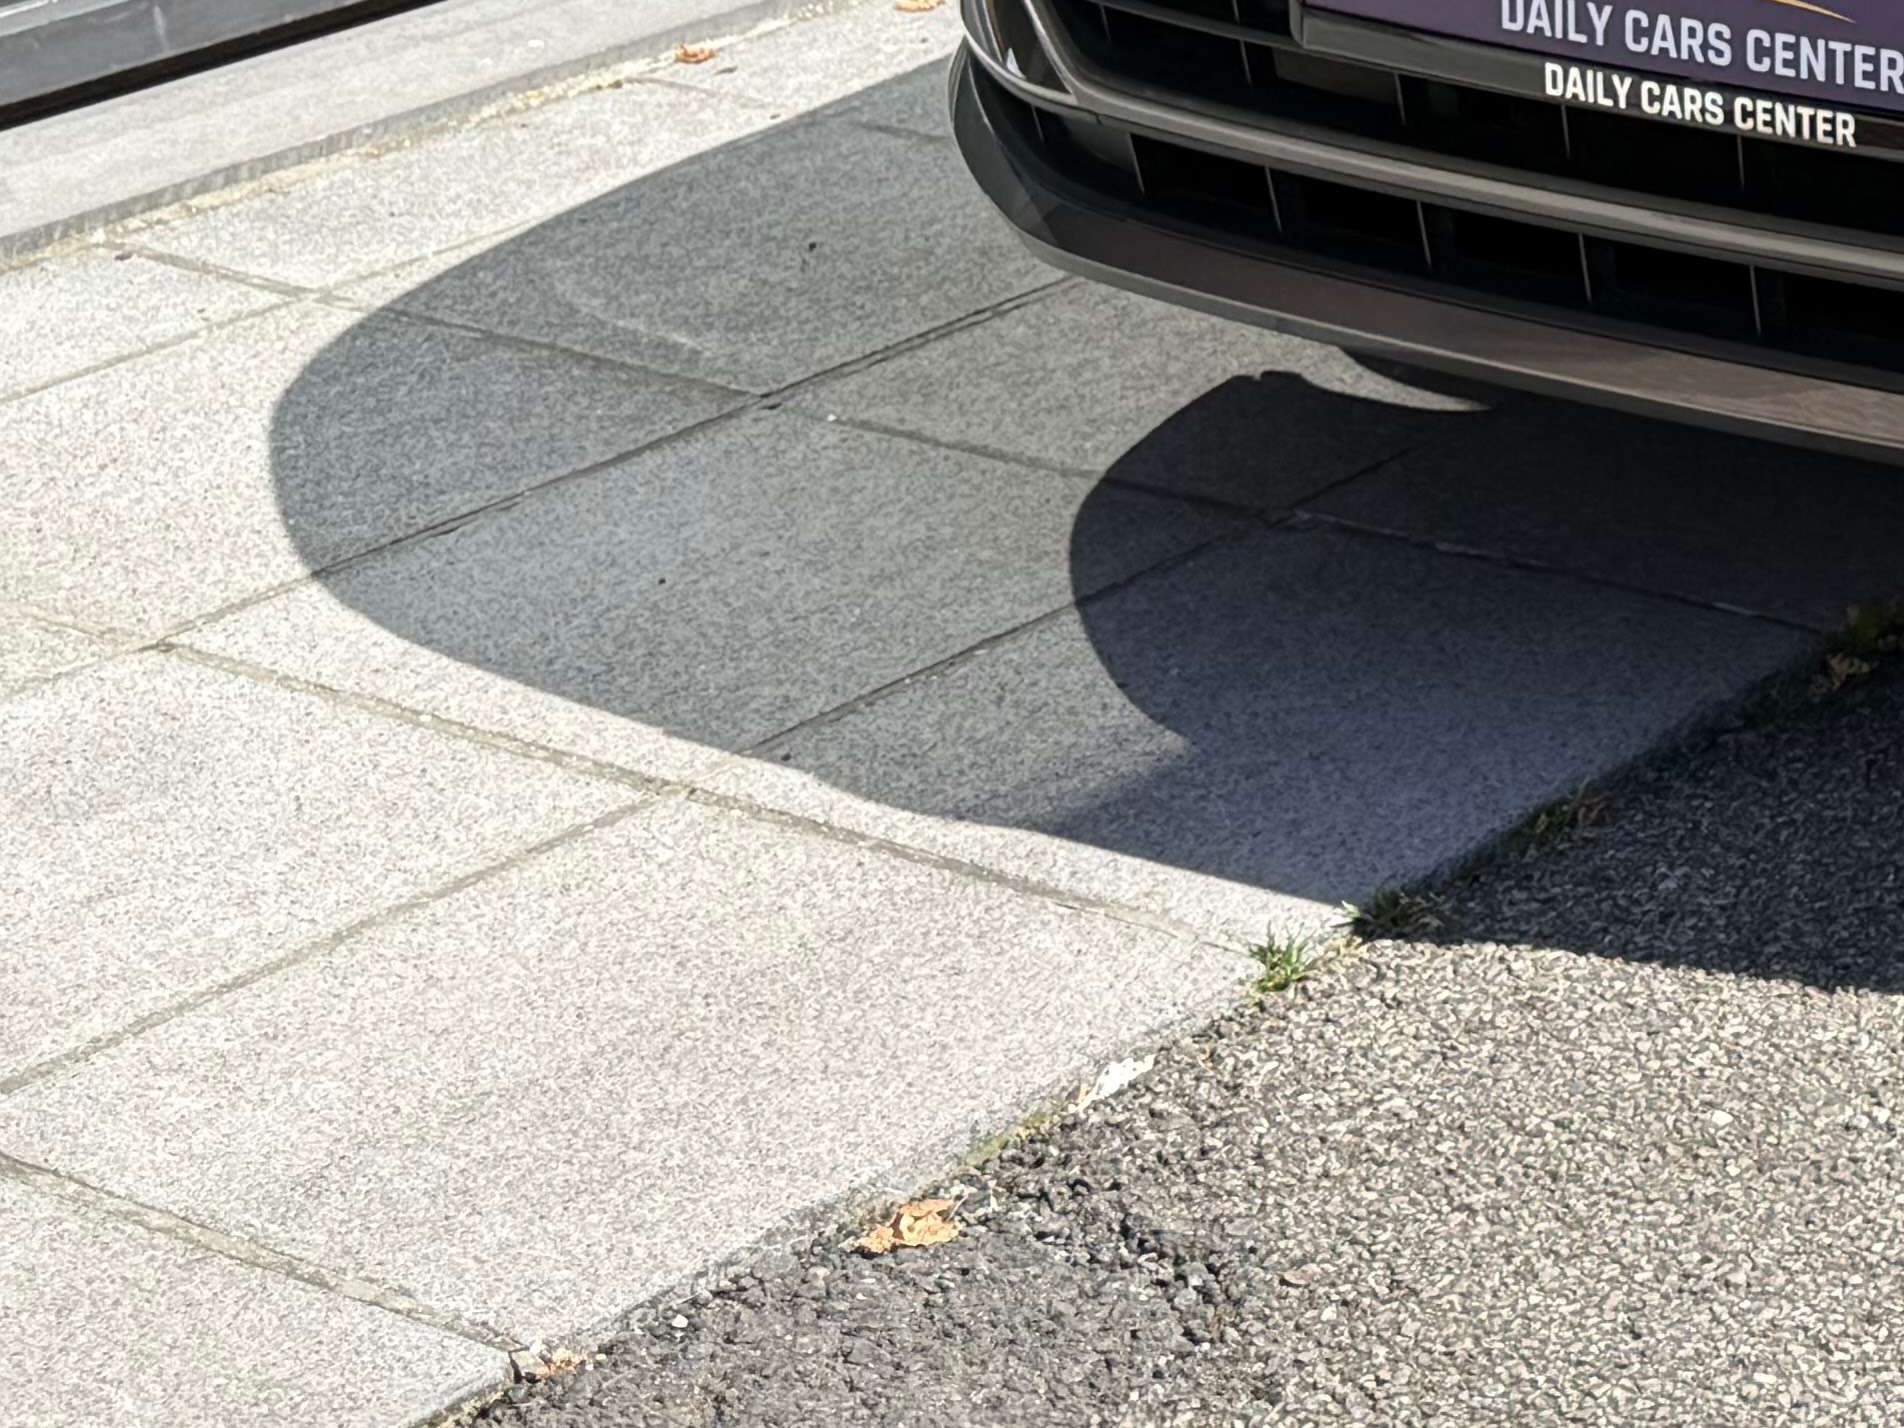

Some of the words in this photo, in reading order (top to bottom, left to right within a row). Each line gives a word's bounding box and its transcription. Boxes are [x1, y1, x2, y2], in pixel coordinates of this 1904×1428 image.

[1624, 9, 1733, 67] CARS
[1544, 61, 1634, 110] DAILY
[1640, 79, 1725, 127] CARS
[1733, 95, 1857, 148] CENTER
